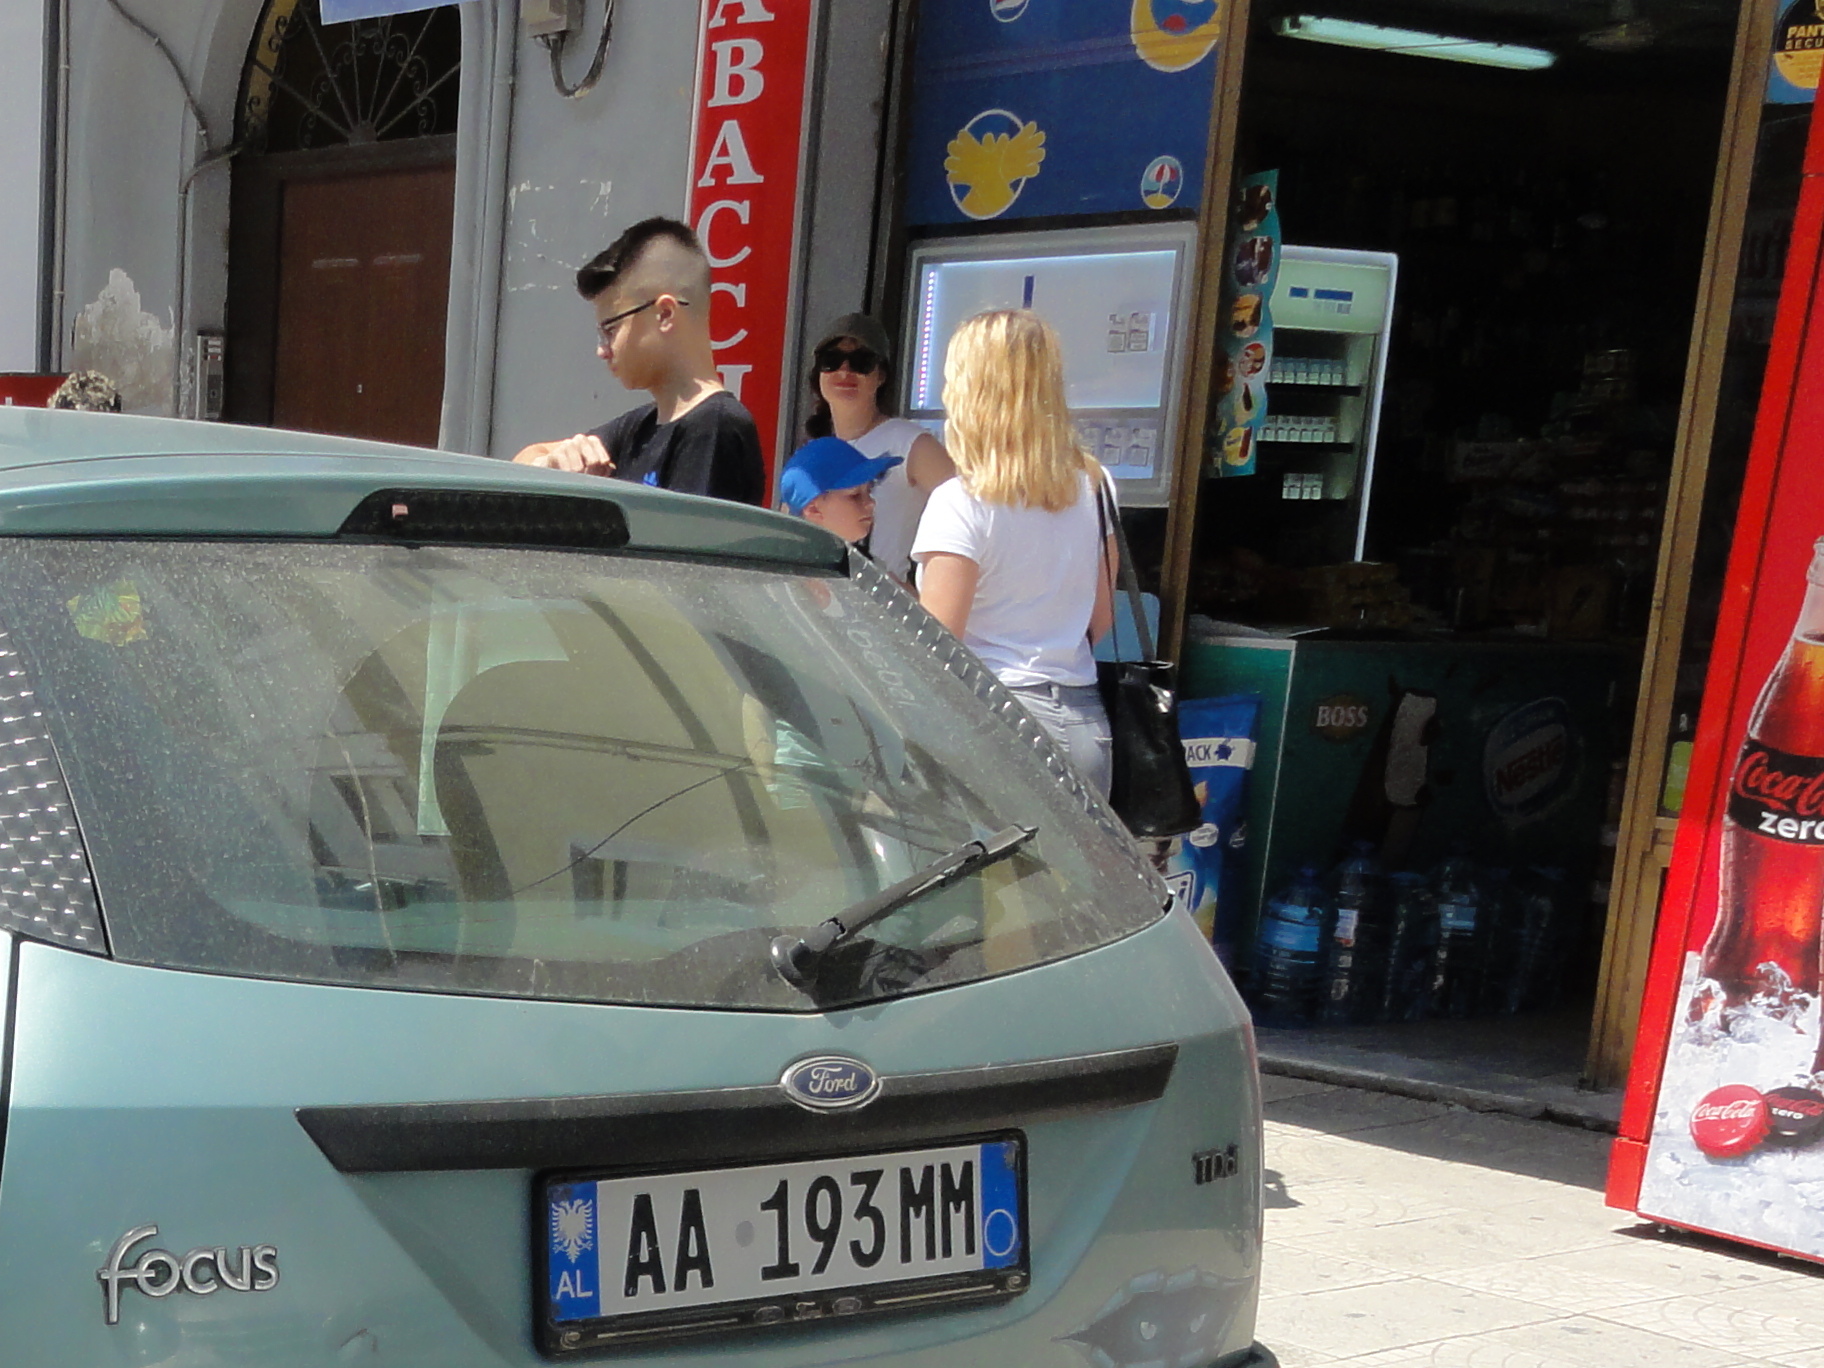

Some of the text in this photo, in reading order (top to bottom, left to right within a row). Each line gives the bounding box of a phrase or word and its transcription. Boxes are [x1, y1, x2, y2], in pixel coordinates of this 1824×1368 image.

[1315, 705, 1368, 727] BOSS
[808, 1066, 858, 1093] Ford
[1691, 1099, 1763, 1122] Coca-Cola
[555, 1270, 594, 1301] AL
[623, 1188, 714, 1298] AA
